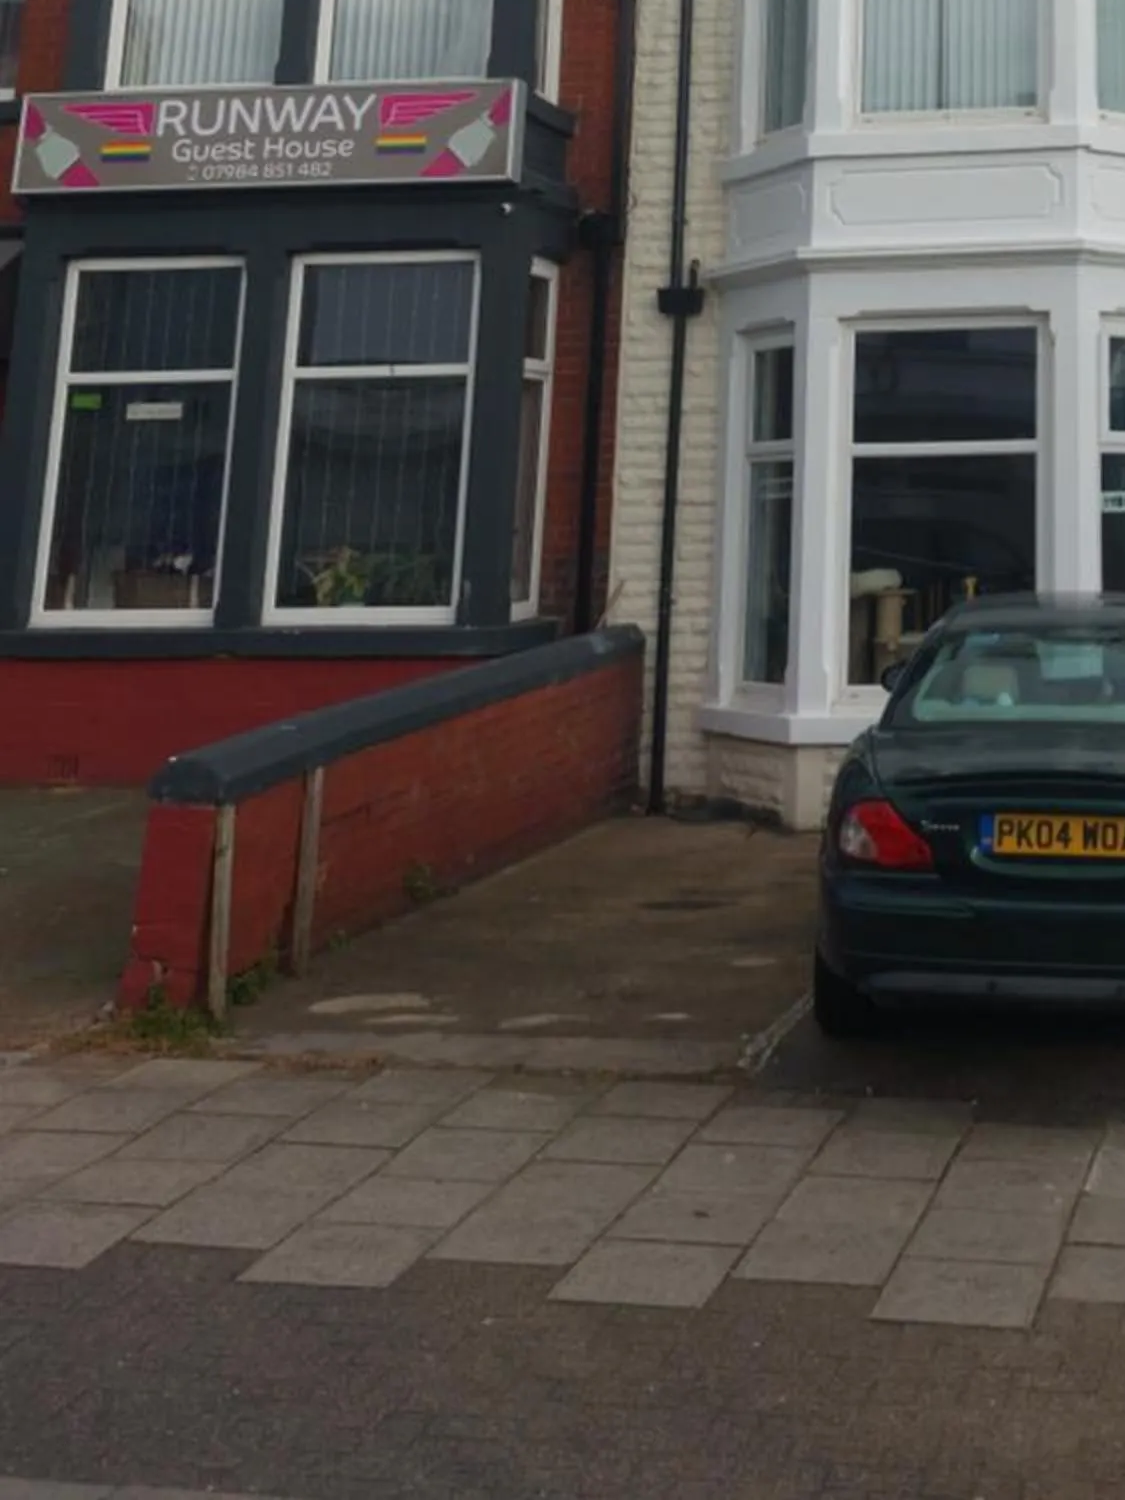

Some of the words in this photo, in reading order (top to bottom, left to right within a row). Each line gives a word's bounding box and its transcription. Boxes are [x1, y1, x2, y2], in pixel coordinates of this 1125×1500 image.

[156, 93, 377, 137] RUNWAY
[171, 137, 256, 162] Guest
[262, 137, 355, 160] House
[997, 818, 1072, 850] PK04
